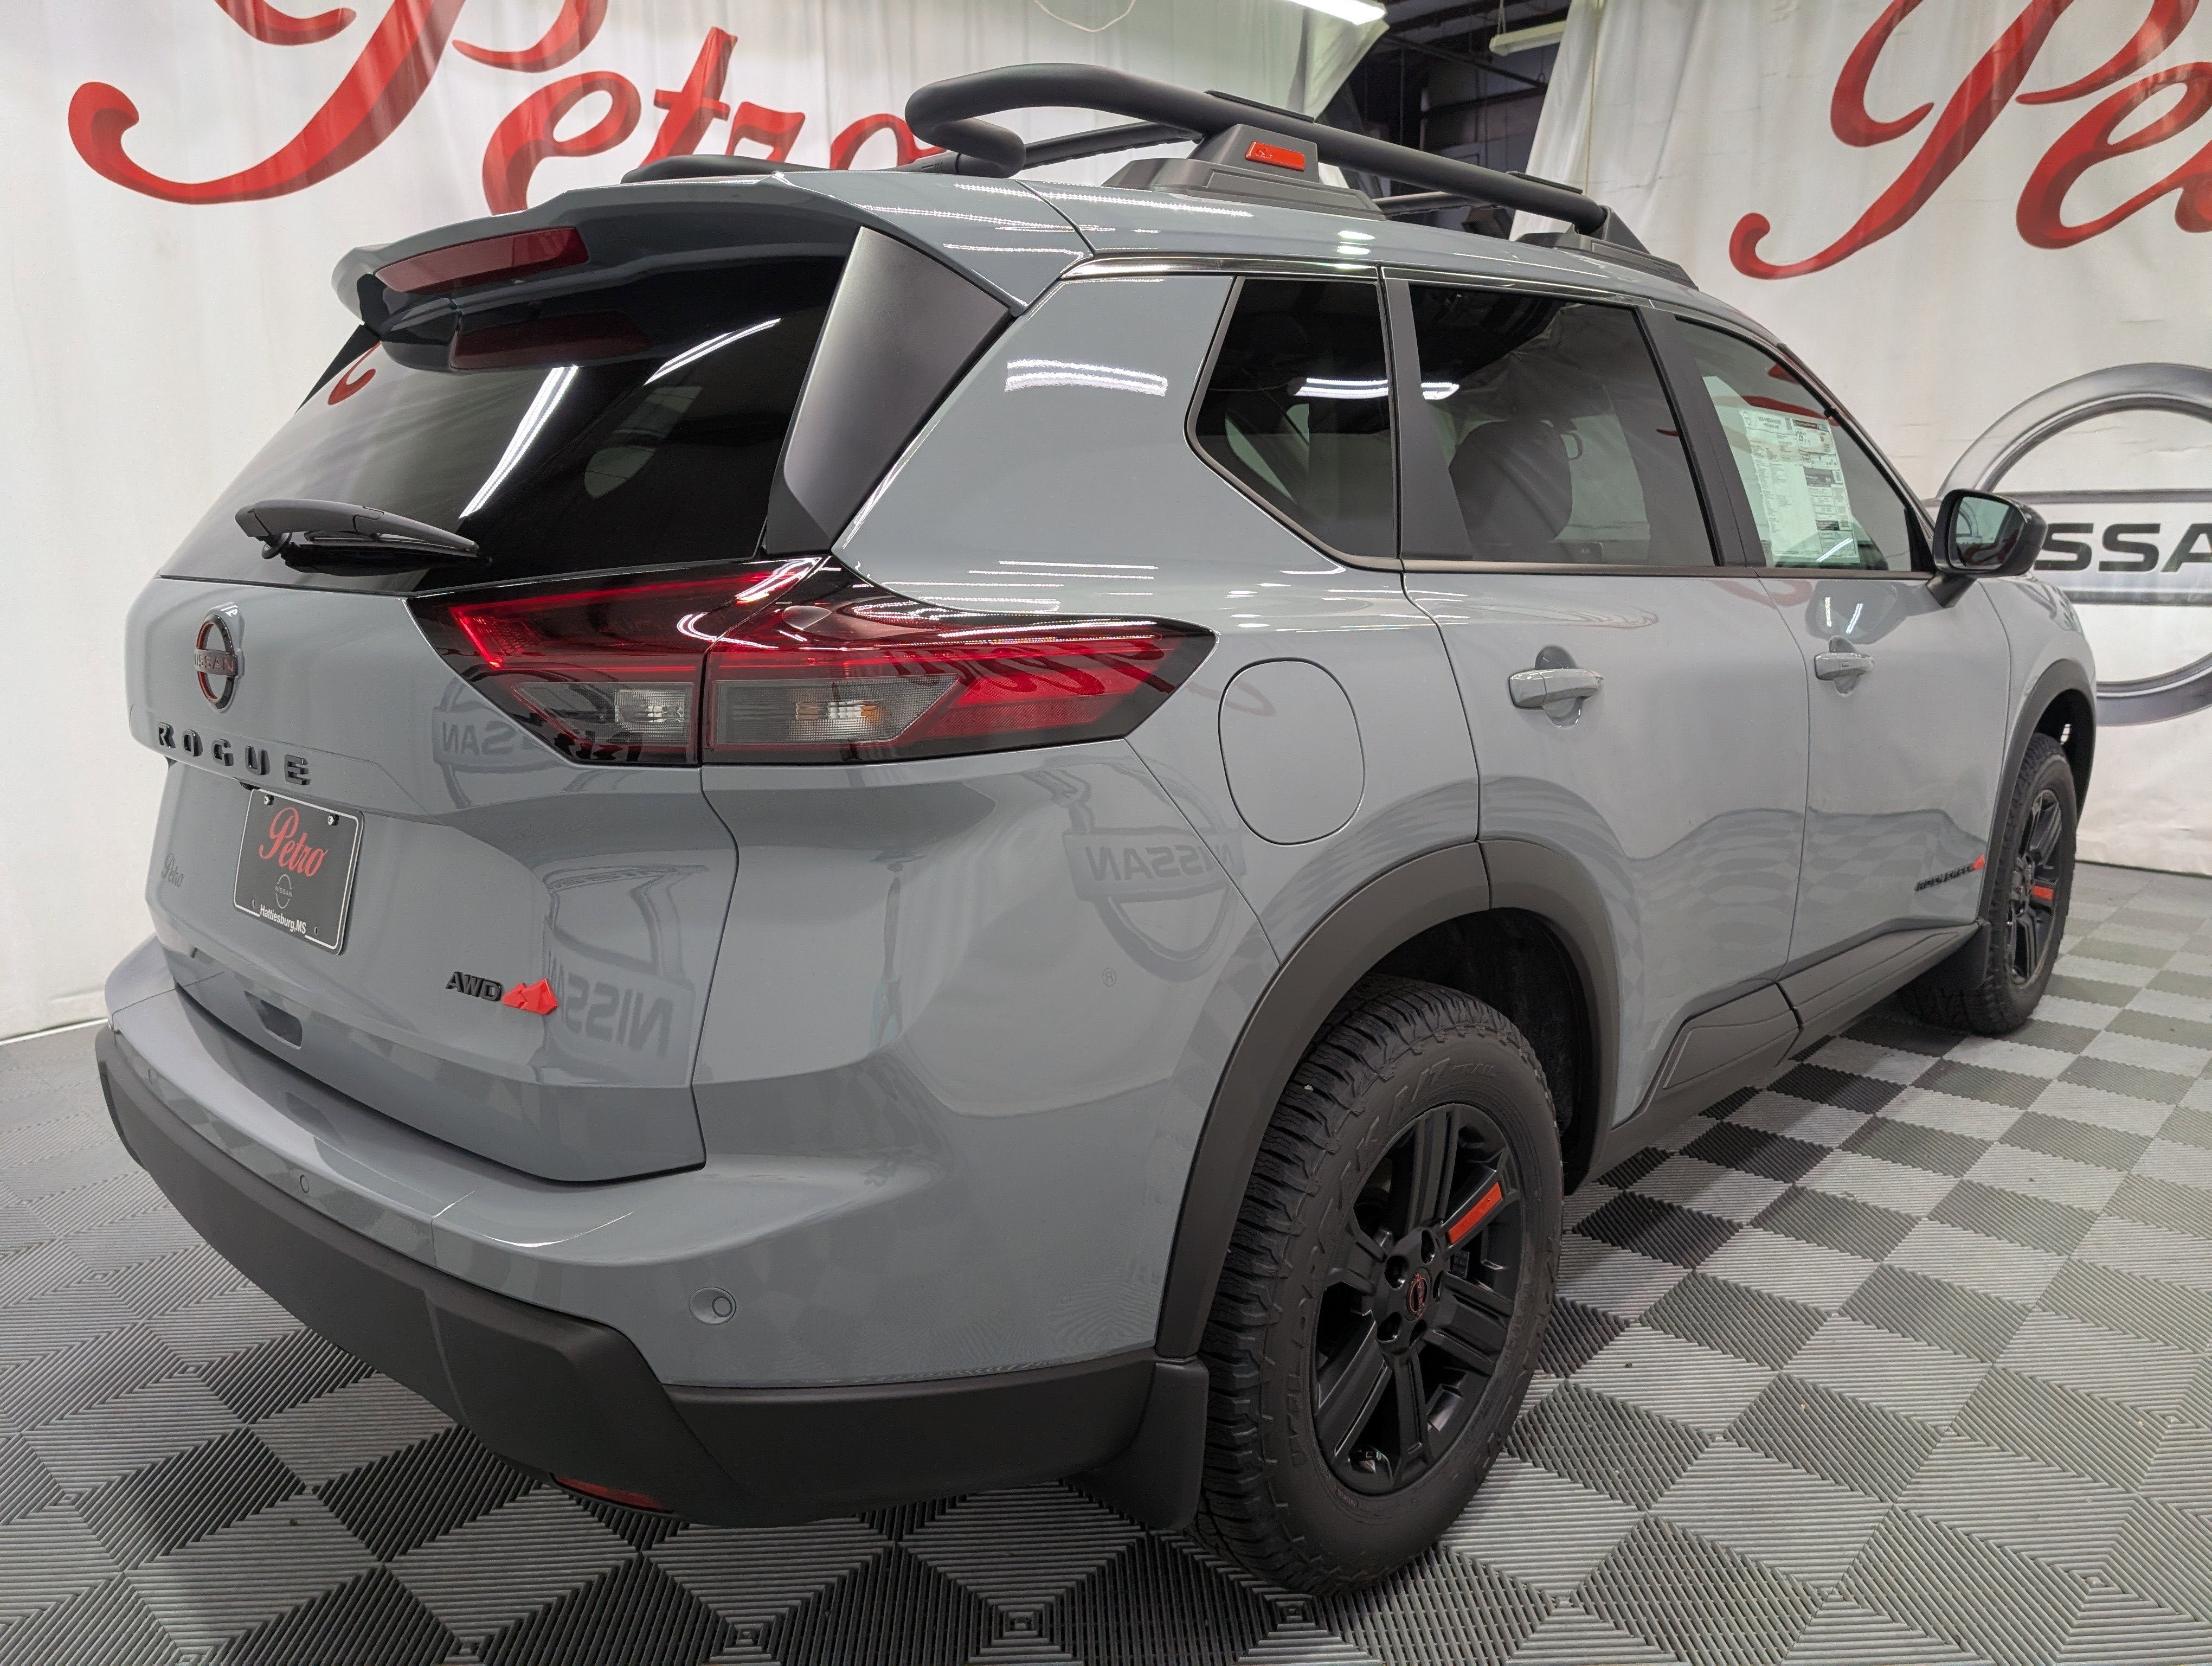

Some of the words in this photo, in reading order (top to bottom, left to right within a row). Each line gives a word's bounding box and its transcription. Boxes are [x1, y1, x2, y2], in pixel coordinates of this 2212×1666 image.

[2034, 522, 2212, 573] SSA
[158, 721, 311, 786] ROGUE
[259, 806, 329, 877] Petro
[161, 852, 183, 887] Petro
[274, 885, 293, 898] NISSAN
[445, 971, 505, 1003] AWD
